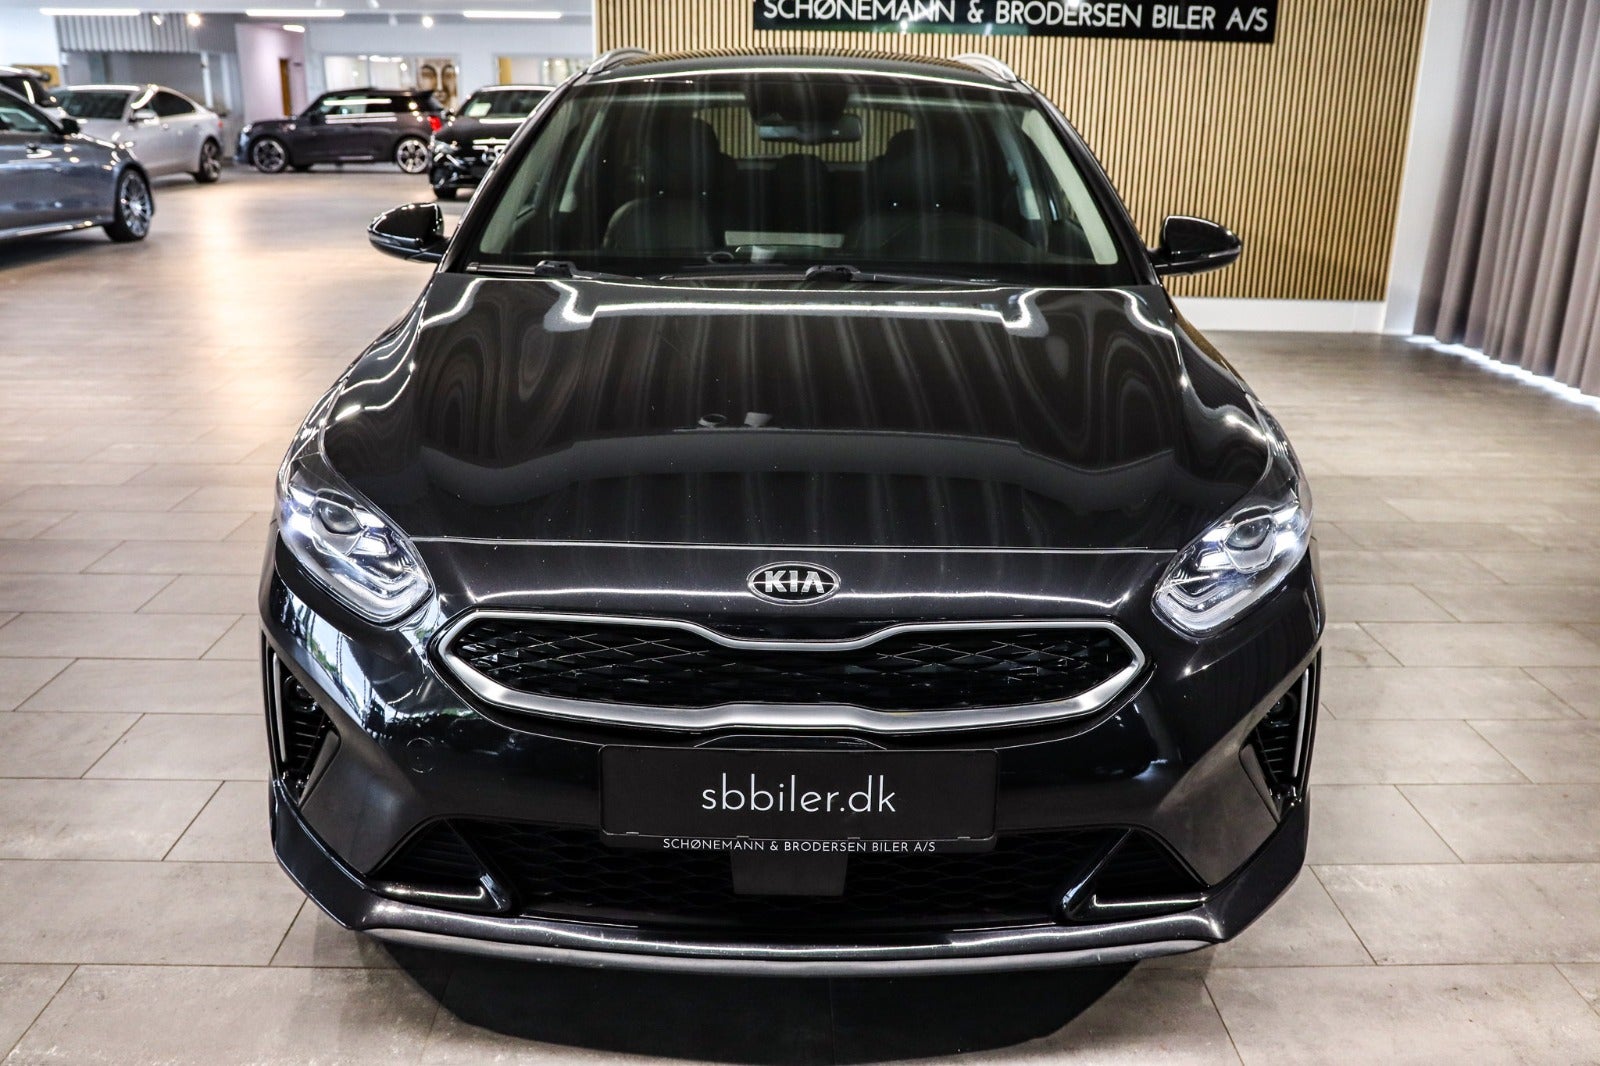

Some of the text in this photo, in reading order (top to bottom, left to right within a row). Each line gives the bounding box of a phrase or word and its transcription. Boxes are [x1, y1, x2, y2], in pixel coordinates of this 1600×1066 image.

[763, 0, 1269, 32] SCHØNEMANN & BRODERSEN BILER A/S
[764, 570, 825, 594] KIA
[701, 772, 896, 813] sbbiler.dk
[663, 838, 936, 852] SCHØNEMANN & BRODERSEN BILER A/S
